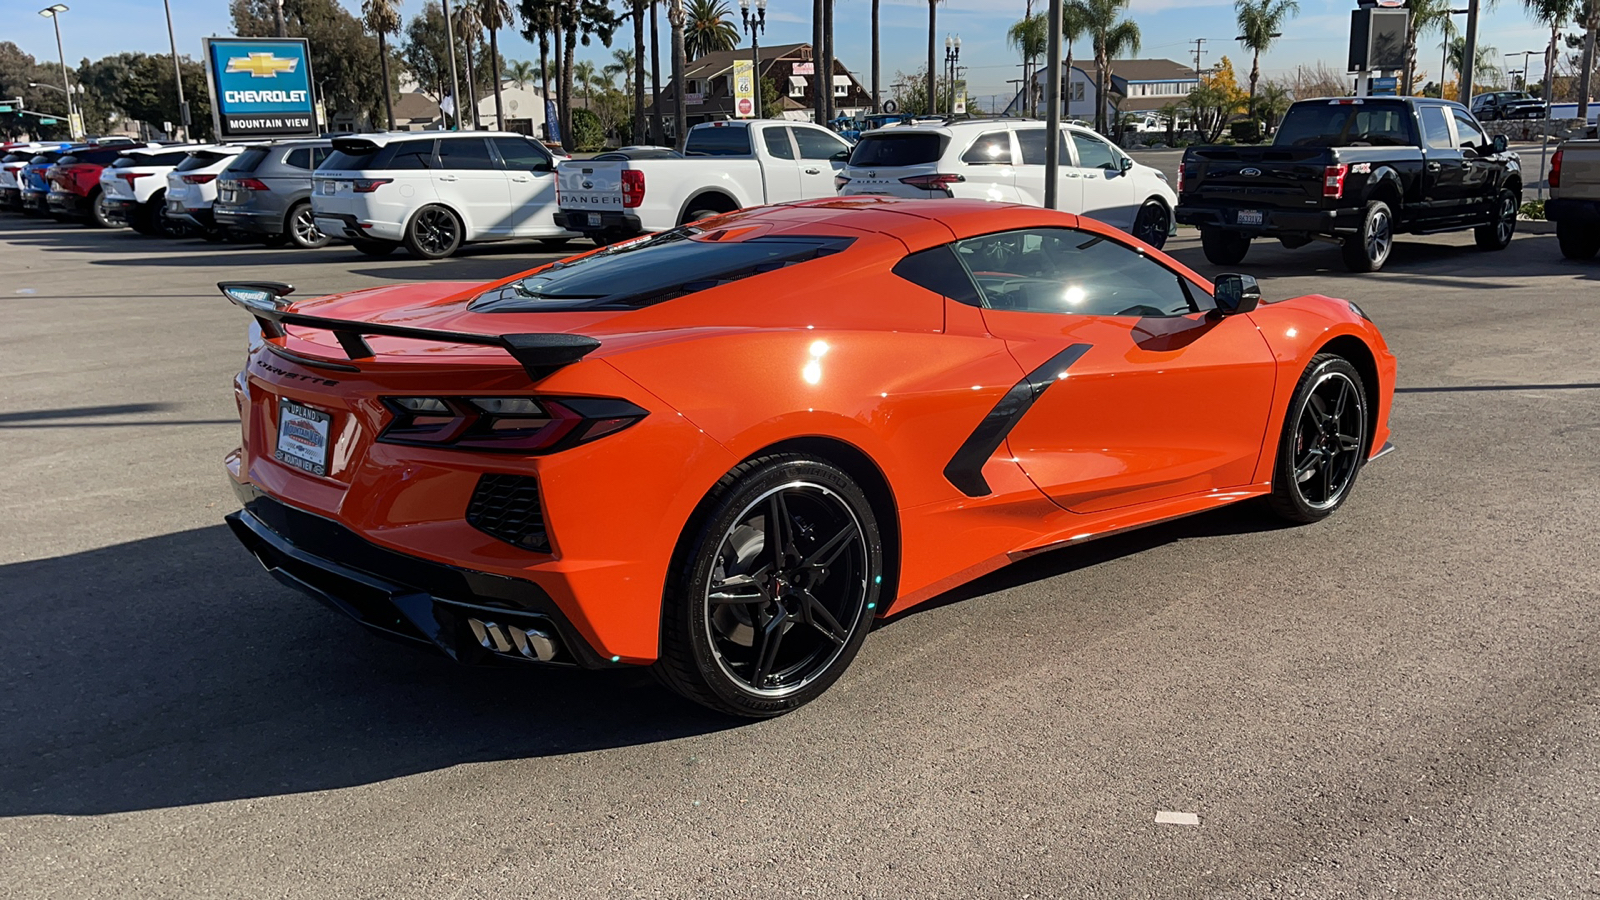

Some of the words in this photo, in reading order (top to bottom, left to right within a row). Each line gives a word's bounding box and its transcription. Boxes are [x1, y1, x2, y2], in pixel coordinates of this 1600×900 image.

[740, 84, 749, 92] 66
[224, 90, 307, 103] CHEVROLET
[230, 119, 282, 129] MOUNTAIN
[285, 118, 309, 127] VIEW
[561, 195, 621, 204] RANGER
[257, 360, 339, 387] CORVETTE
[291, 404, 316, 420] UPLAND
